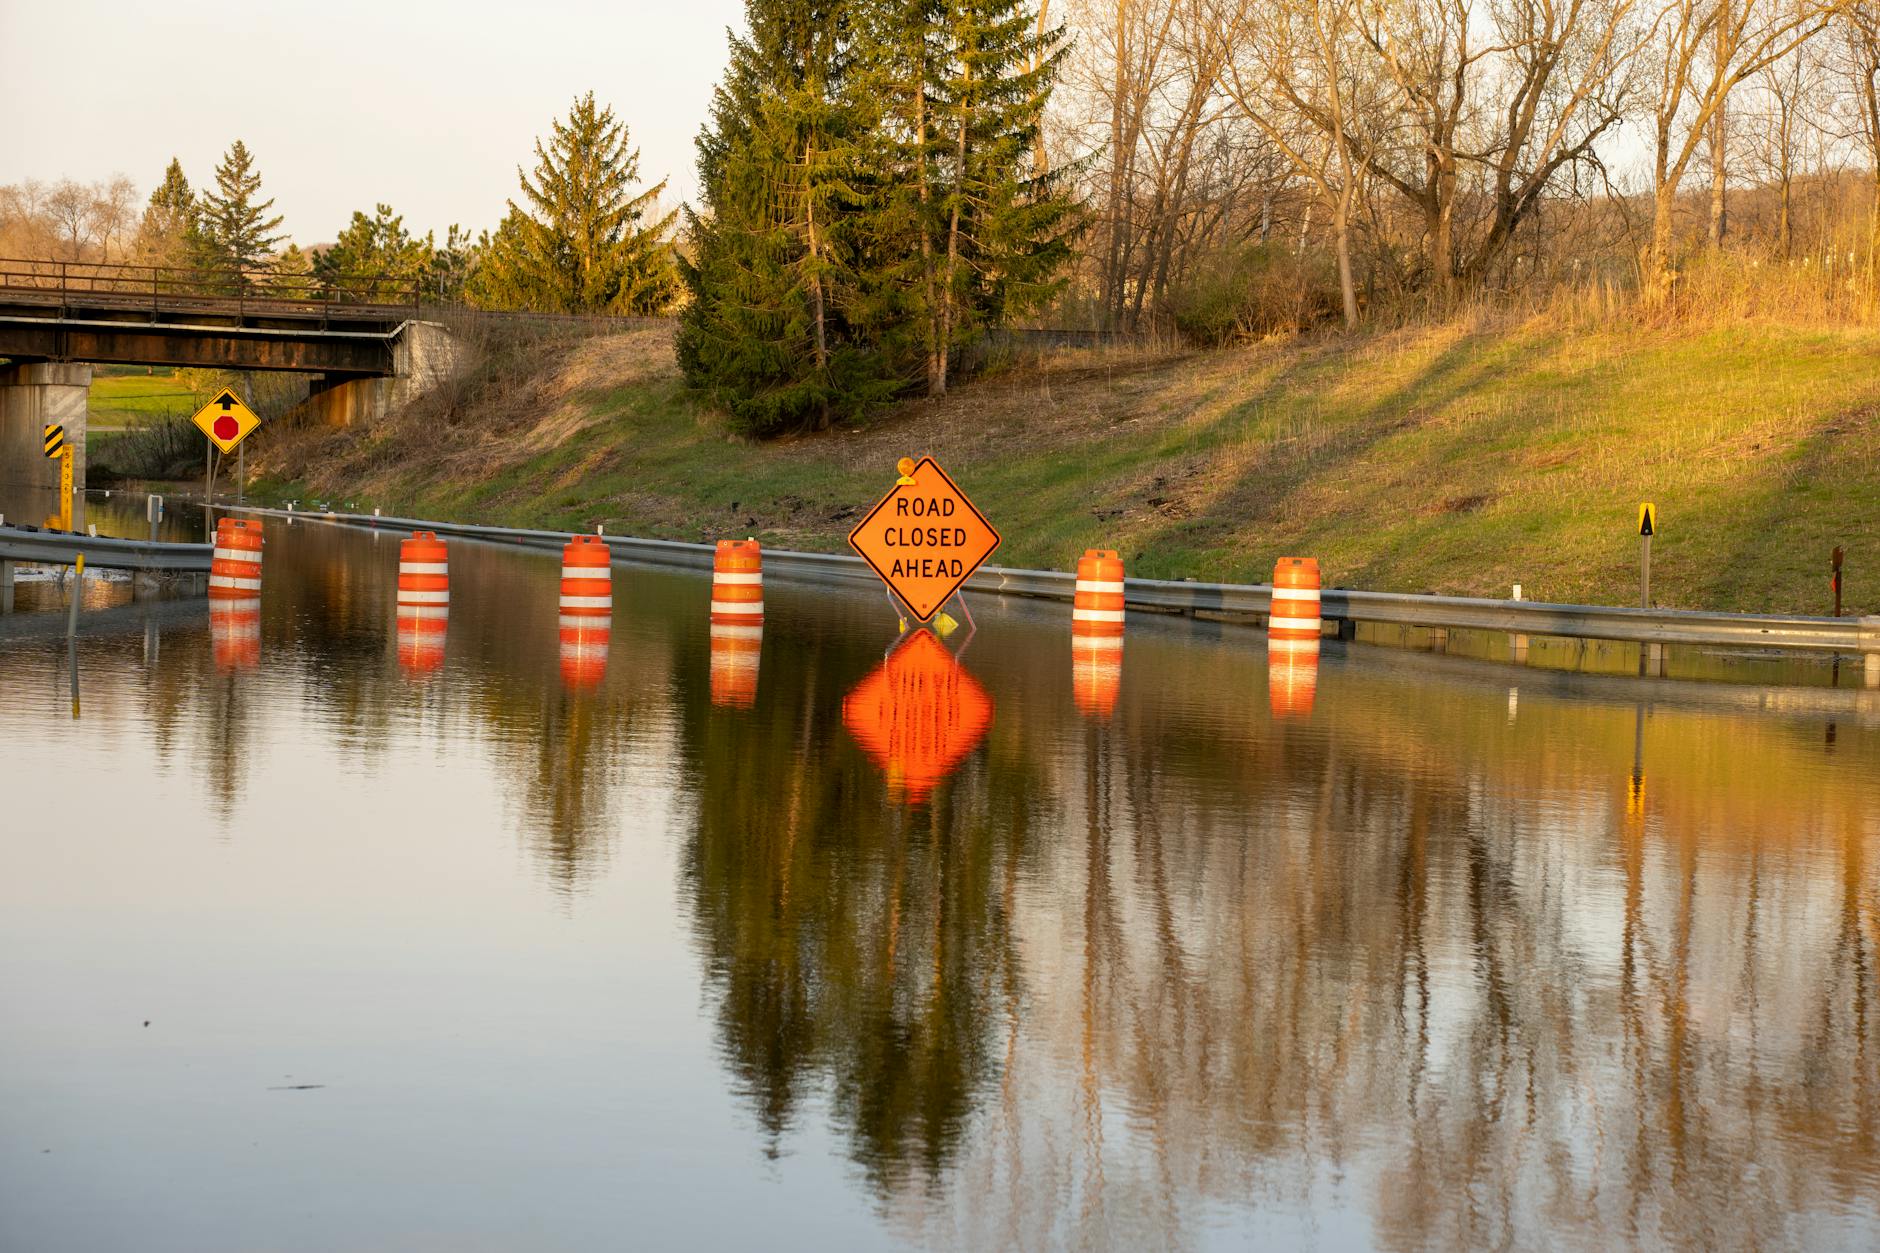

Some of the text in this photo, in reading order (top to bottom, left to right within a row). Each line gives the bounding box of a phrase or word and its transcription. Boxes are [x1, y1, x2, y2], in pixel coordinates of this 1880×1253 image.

[897, 497, 955, 517] ROAD
[884, 527, 967, 547] CLOSED
[890, 559, 963, 578] AHEAD
